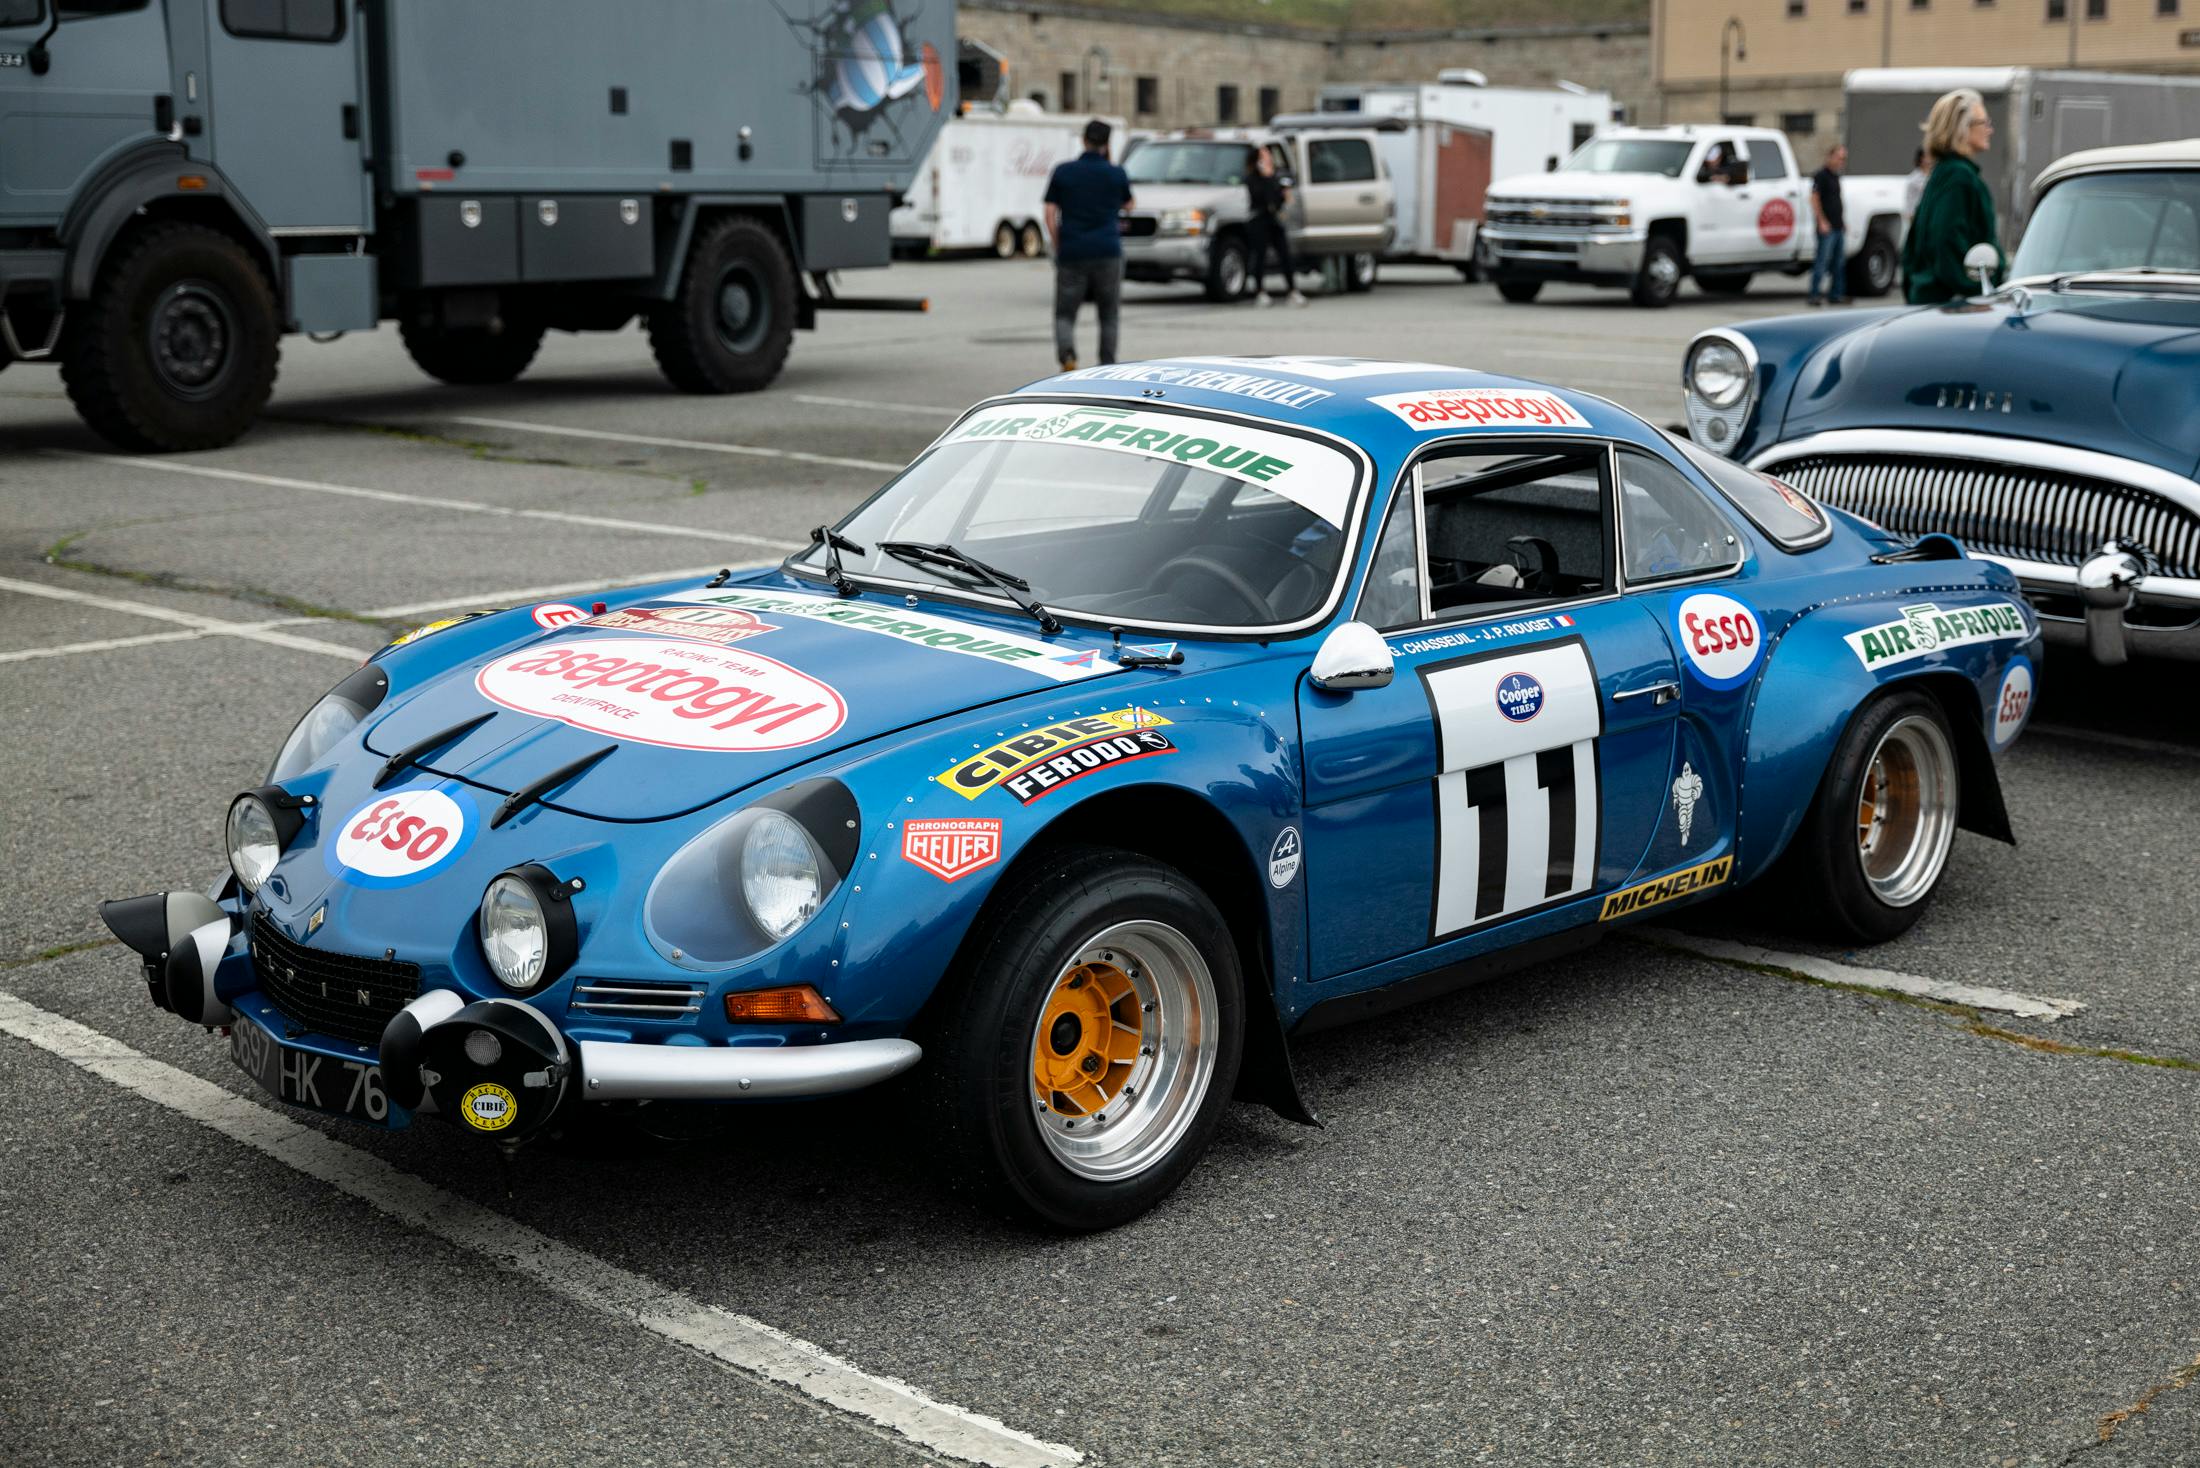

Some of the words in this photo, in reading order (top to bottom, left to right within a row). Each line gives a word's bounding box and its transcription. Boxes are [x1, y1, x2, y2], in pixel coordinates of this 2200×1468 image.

[1177, 368, 1330, 406] RENAULT
[1397, 397, 1575, 425] aseptogyl
[957, 417, 1037, 439] AIR
[1058, 420, 1294, 482] AFRIQUE
[543, 610, 582, 626] E
[703, 594, 792, 612] AIR
[822, 609, 1043, 662] AFRIQUE
[1861, 624, 1916, 663] AIR
[1932, 606, 2022, 642] AFRIQUE
[1405, 632, 1476, 655] CHASSEUIL
[1482, 629, 1493, 640] J.
[1496, 626, 1507, 638] P.
[1507, 618, 1555, 636] ROUGET
[659, 647, 716, 665] RACING
[719, 659, 767, 678] TEAM
[506, 649, 827, 735] aseptogyl
[551, 693, 641, 720] DENTIFRICE
[1500, 686, 1540, 704] Cooper
[1511, 702, 1536, 715] TIRES
[1007, 736, 1141, 799] FERODO
[908, 821, 999, 831] CHRONOGRAPH
[1465, 743, 1577, 921] 11
[912, 835, 990, 870] HEUER
[1272, 860, 1296, 877] Alpine
[1603, 860, 1729, 918] MICHELIN
[279, 1047, 323, 1108] HK
[343, 1060, 388, 1121] 76
[469, 1087, 510, 1101] RACING
[474, 1116, 505, 1126] TEAM
